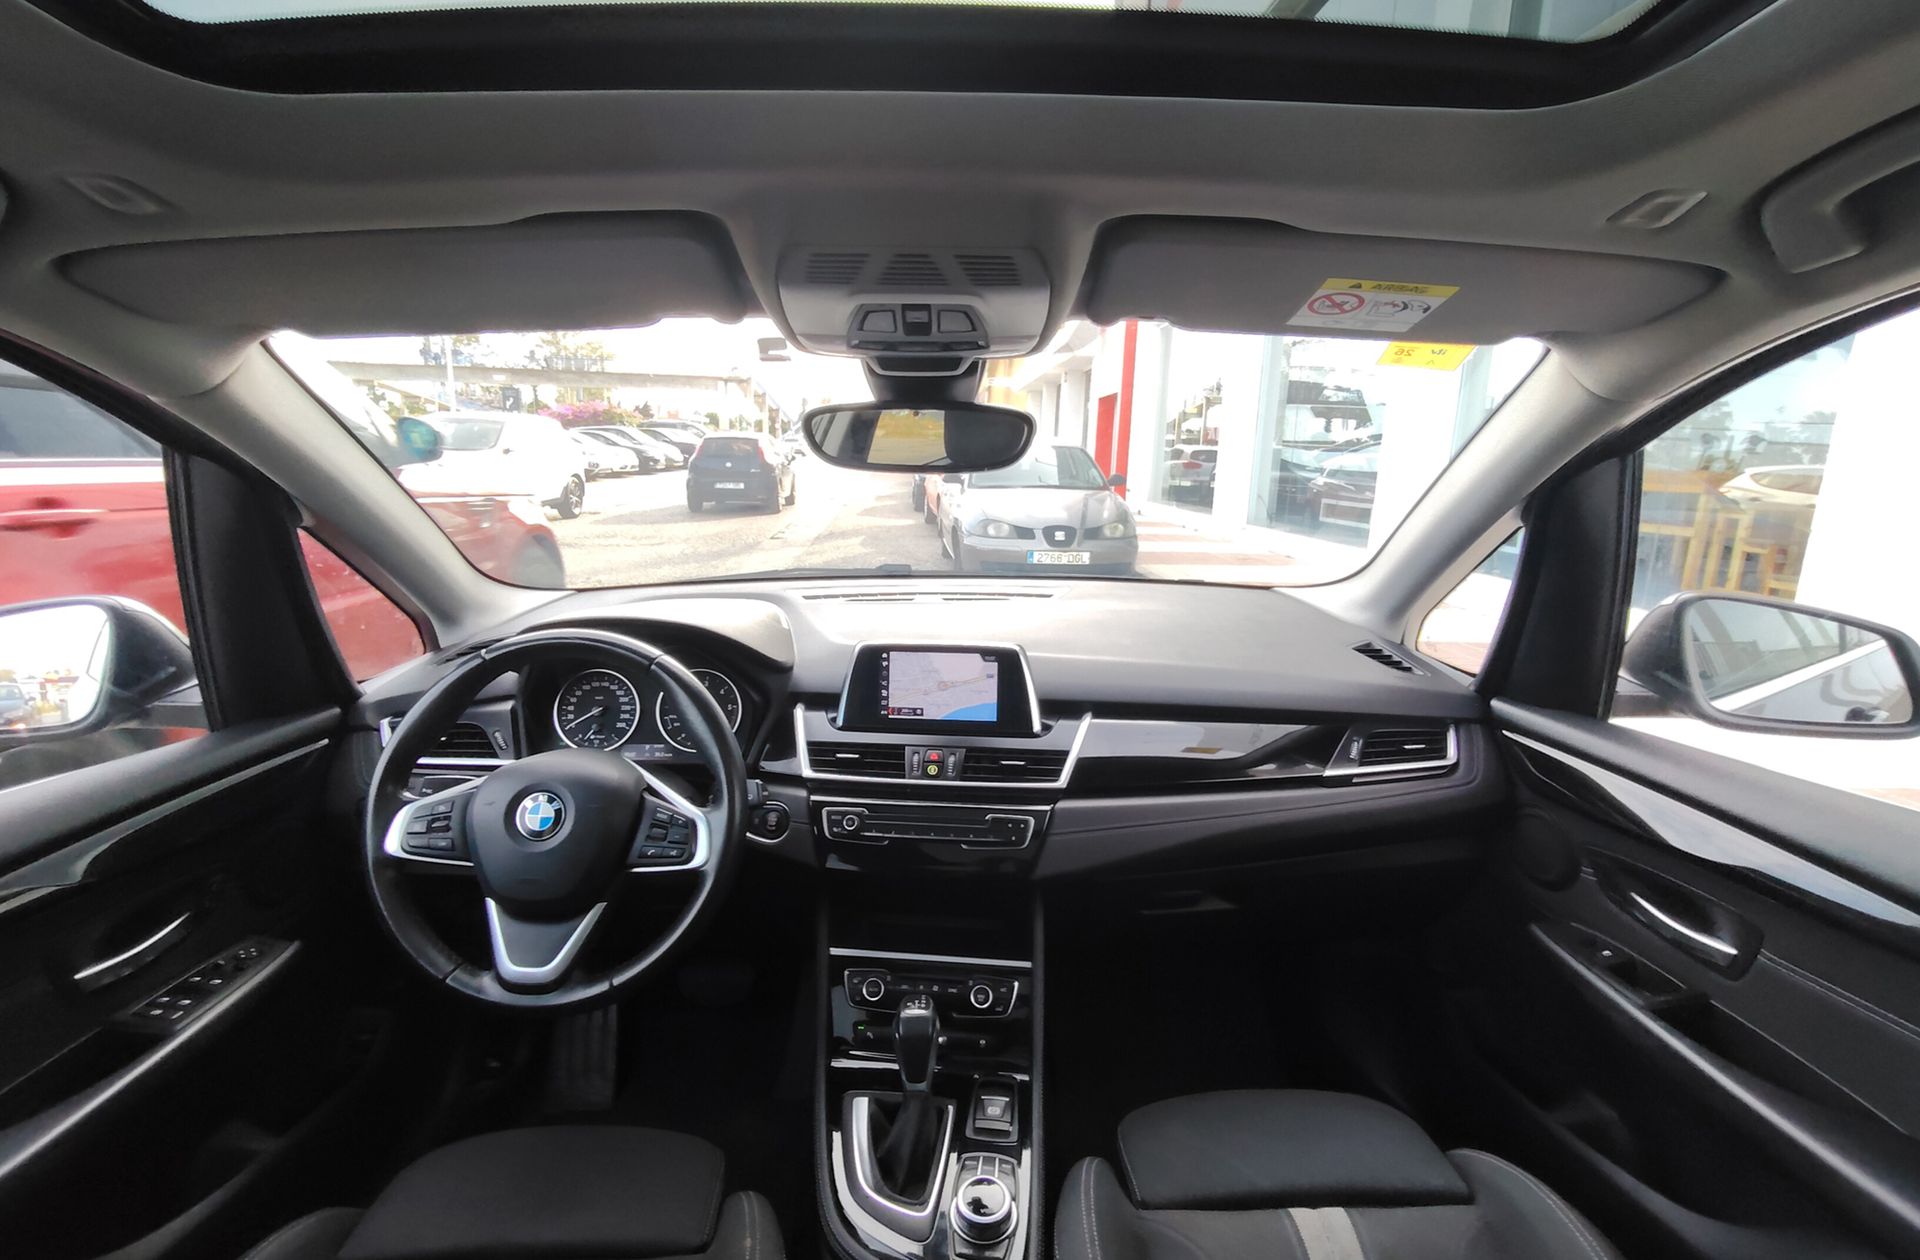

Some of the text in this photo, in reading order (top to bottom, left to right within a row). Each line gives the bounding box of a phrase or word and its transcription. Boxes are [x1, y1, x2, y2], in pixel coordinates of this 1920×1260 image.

[1036, 553, 1087, 563] 2766 DGL
[524, 794, 562, 810] BMW
